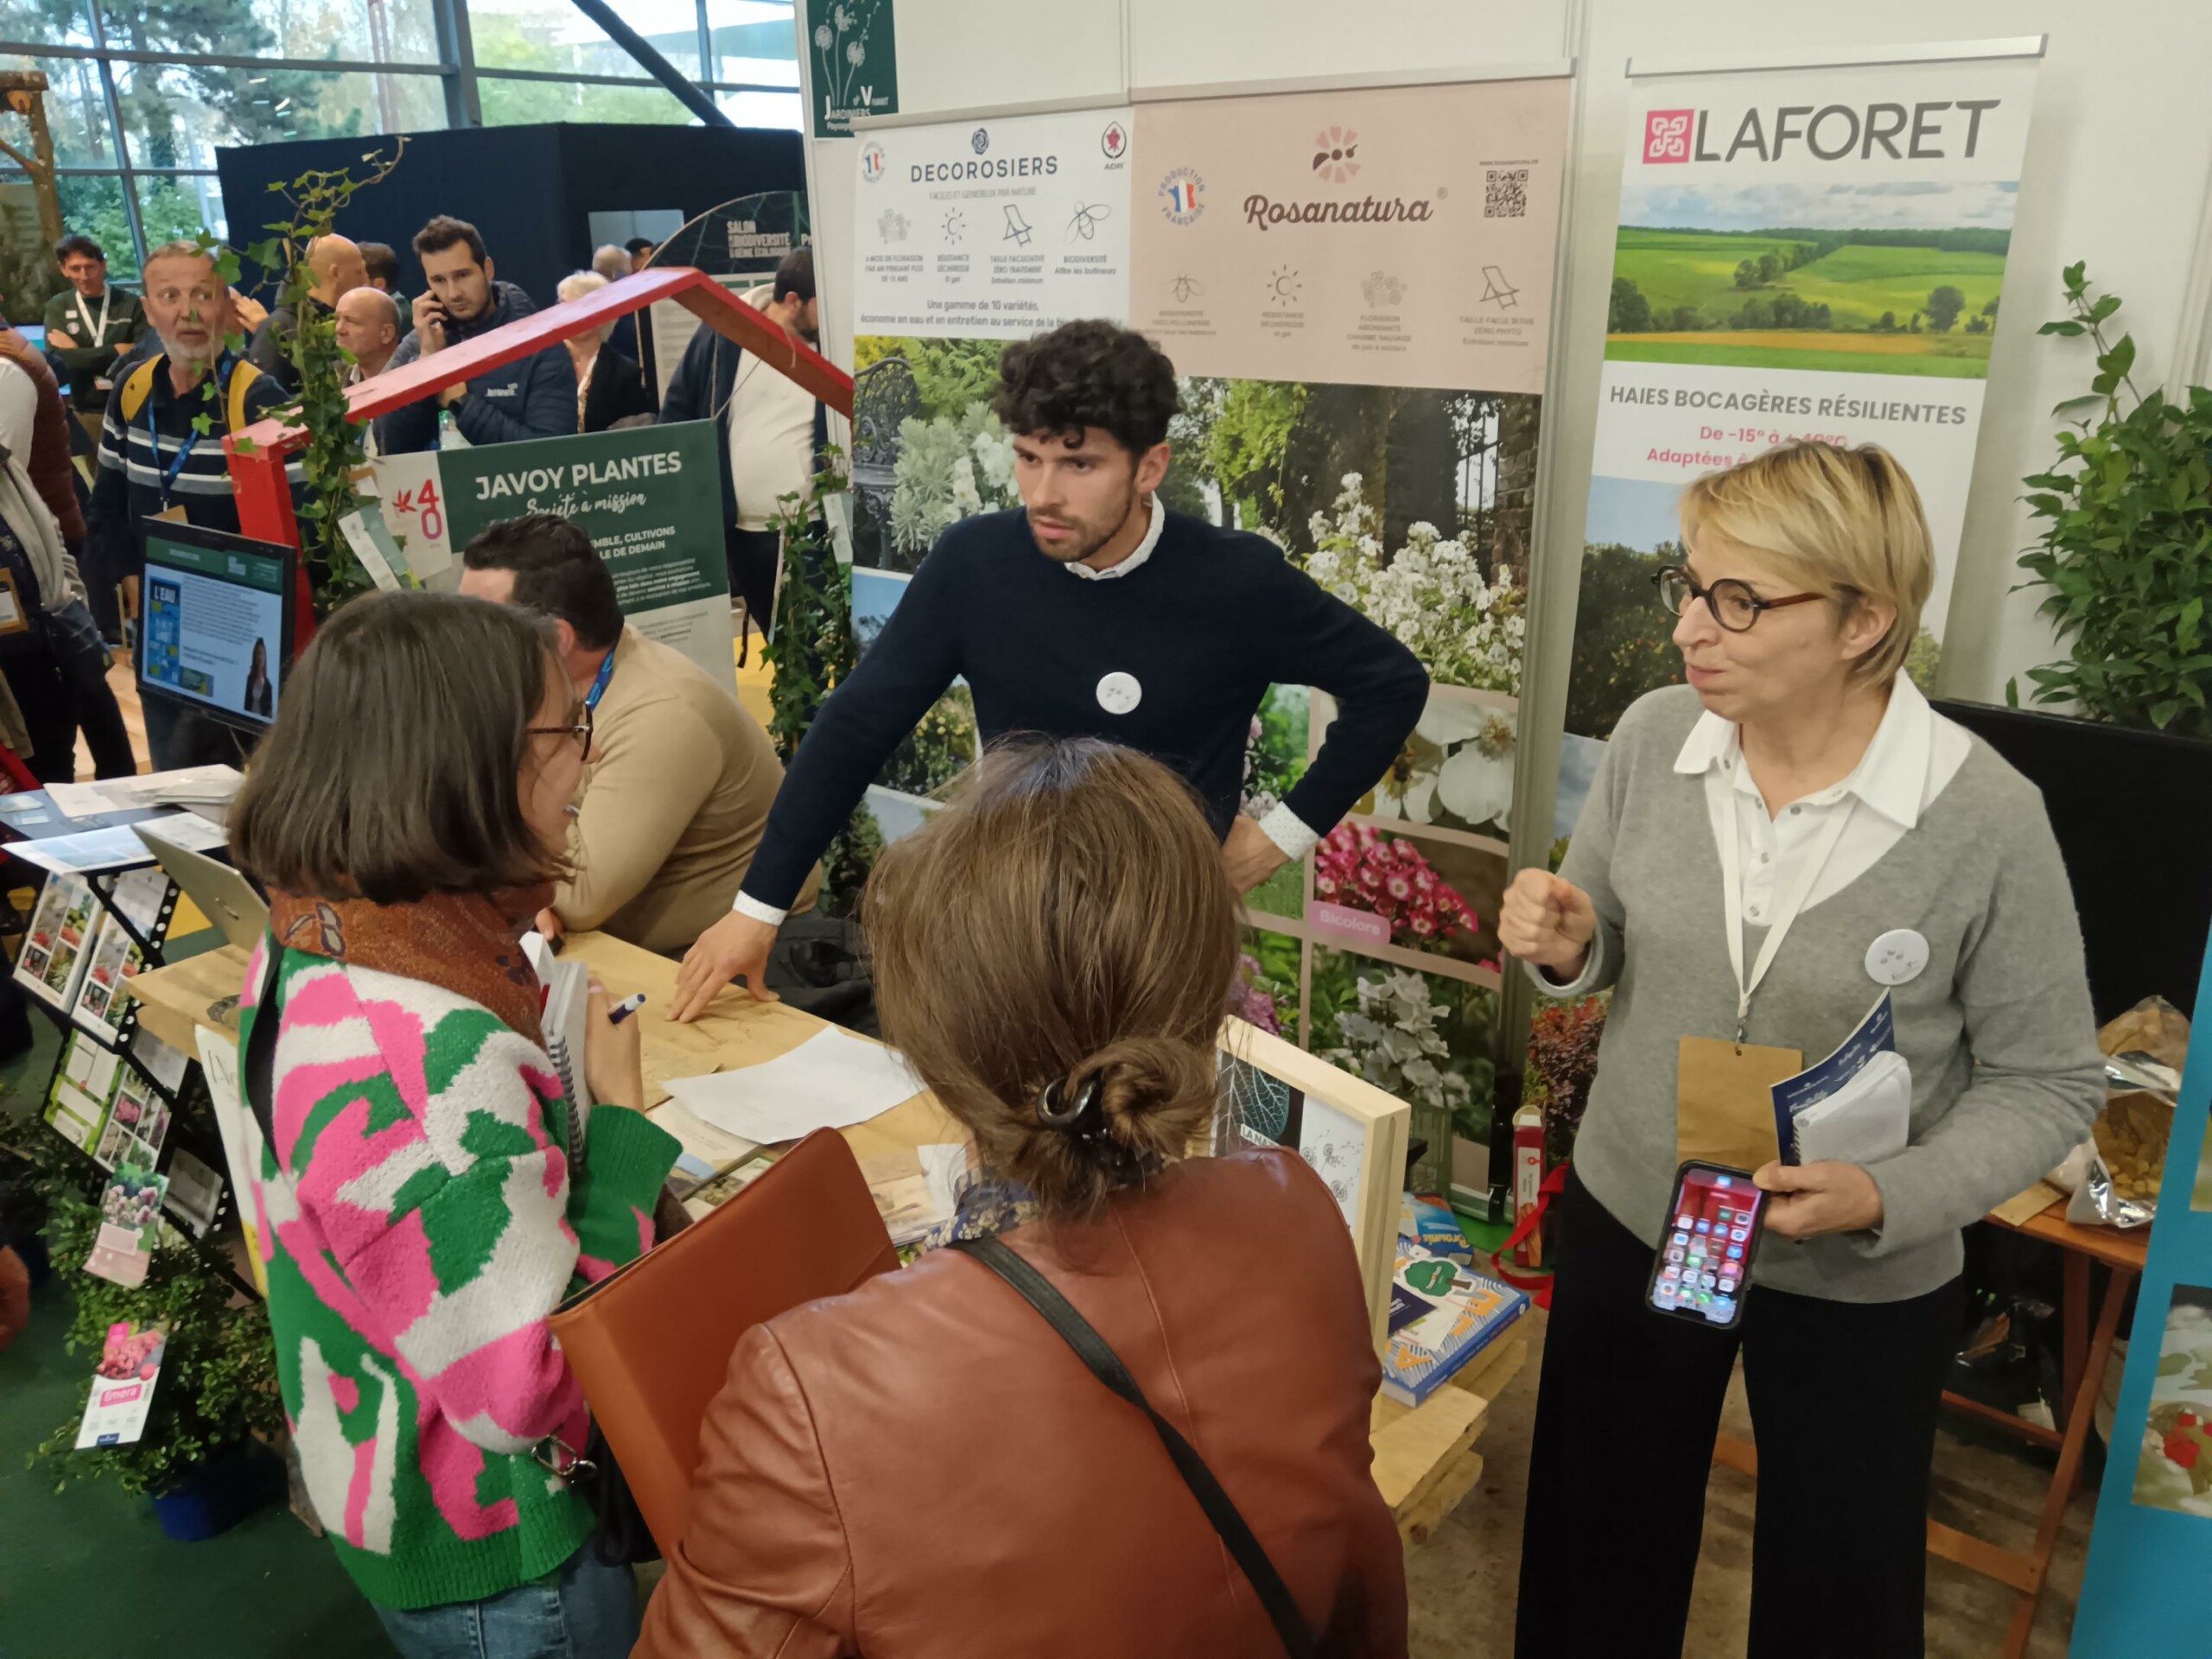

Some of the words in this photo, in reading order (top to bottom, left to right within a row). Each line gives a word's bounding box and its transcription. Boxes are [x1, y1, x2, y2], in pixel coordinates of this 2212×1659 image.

[1694, 99, 2001, 162] LAFORET
[911, 156, 1058, 183] DECOROSIERS
[1243, 194, 1433, 232] Rosanatura
[927, 300, 942, 309] Une
[944, 302, 976, 312] gamme
[978, 300, 989, 310] de
[991, 300, 1001, 310] 10
[861, 314, 896, 323] économe
[925, 315, 934, 324] et
[947, 315, 988, 325] entretien
[1003, 317, 1034, 327] service
[1035, 318, 1046, 327] de
[1046, 318, 1054, 327] la
[1610, 385, 1669, 405] HAIES
[1675, 389, 1812, 416] BOCAGÈRES
[1818, 395, 1967, 424] RÉSILIENTES
[1700, 426, 1724, 441] De
[1768, 429, 1780, 444] à
[1647, 448, 1732, 468] Adaptées
[475, 466, 564, 500] JAVOY
[572, 451, 682, 486] PLANTES
[581, 490, 592, 512] à
[594, 492, 646, 513] mission
[625, 525, 676, 543] CULTIVONS
[613, 547, 626, 557] DE
[628, 540, 665, 555] DEMAIN
[1320, 909, 1381, 936] Bicolore
[1422, 1233, 1470, 1249] Brownie
